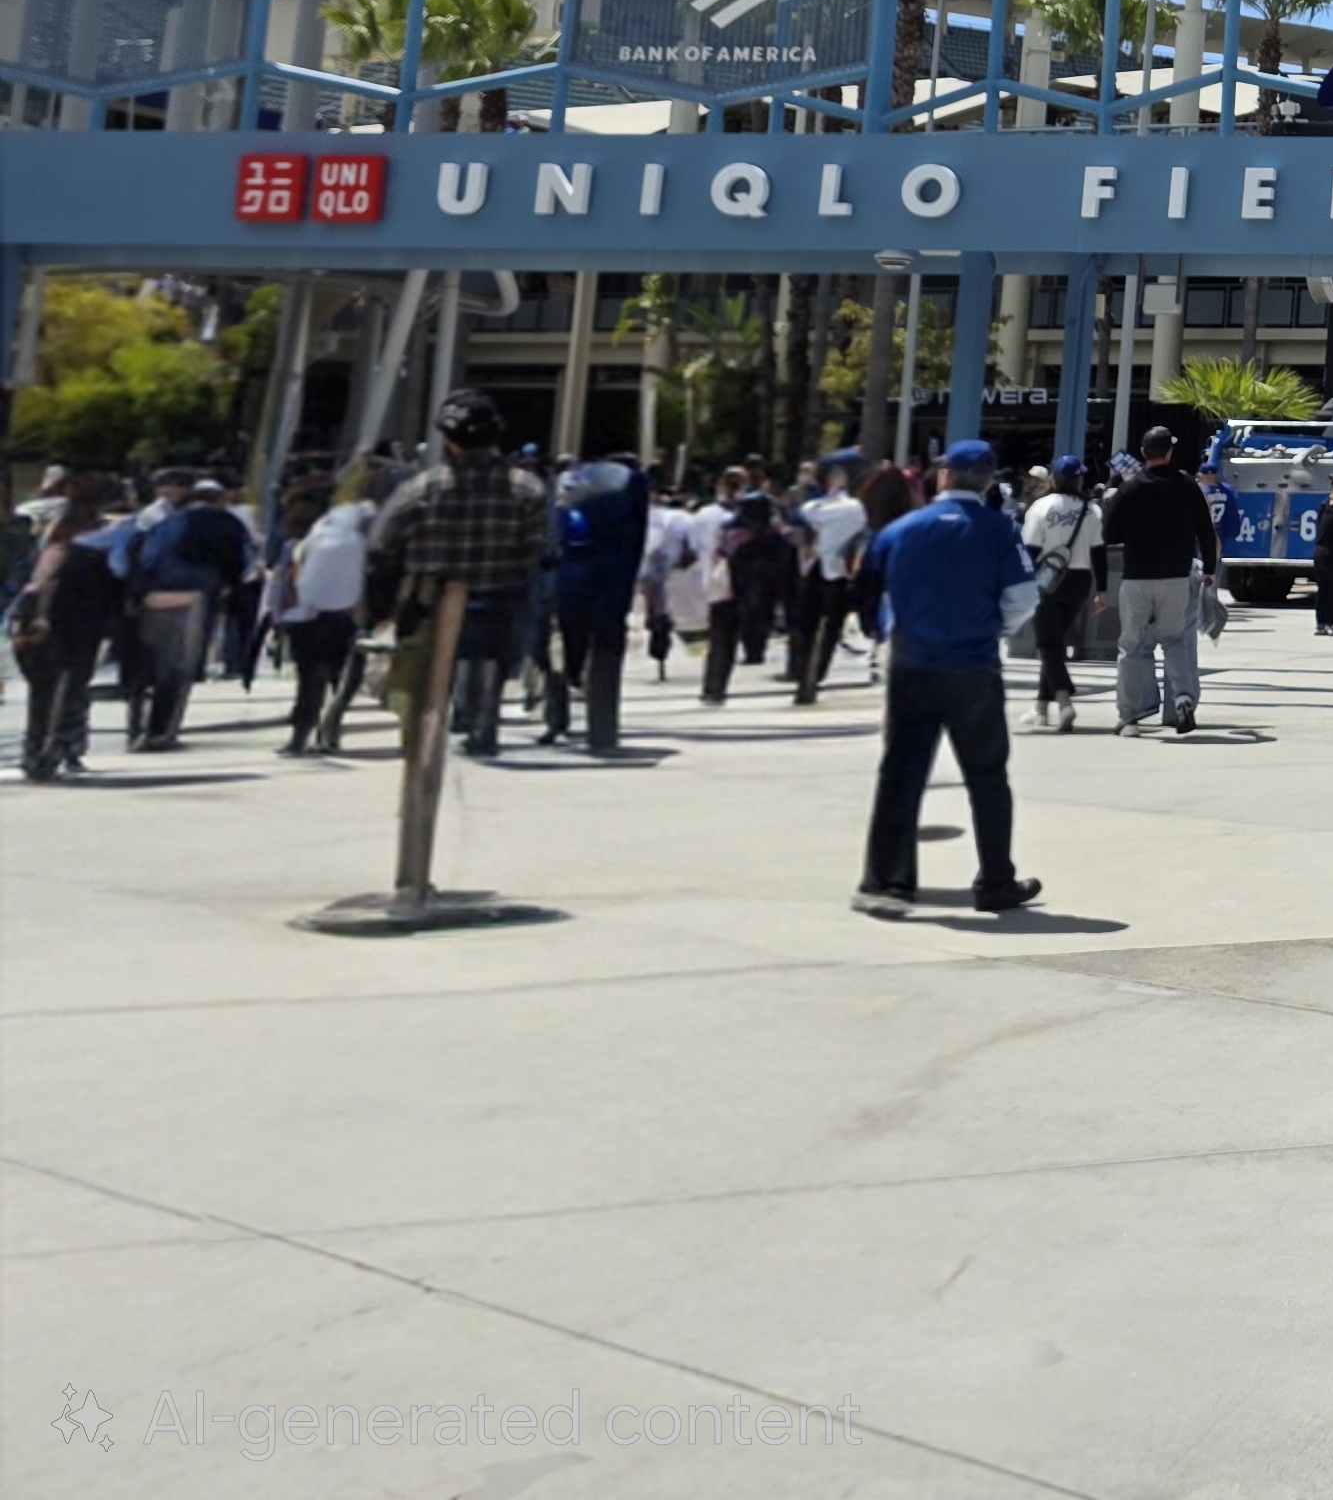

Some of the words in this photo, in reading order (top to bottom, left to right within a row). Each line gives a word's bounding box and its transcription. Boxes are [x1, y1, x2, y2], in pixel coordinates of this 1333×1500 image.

[618, 45, 680, 62] BANK
[684, 45, 712, 62] OF
[717, 45, 817, 62] AMERICA
[321, 162, 368, 187] UNI
[317, 189, 369, 217] QLO
[436, 162, 961, 218] UNIQLO
